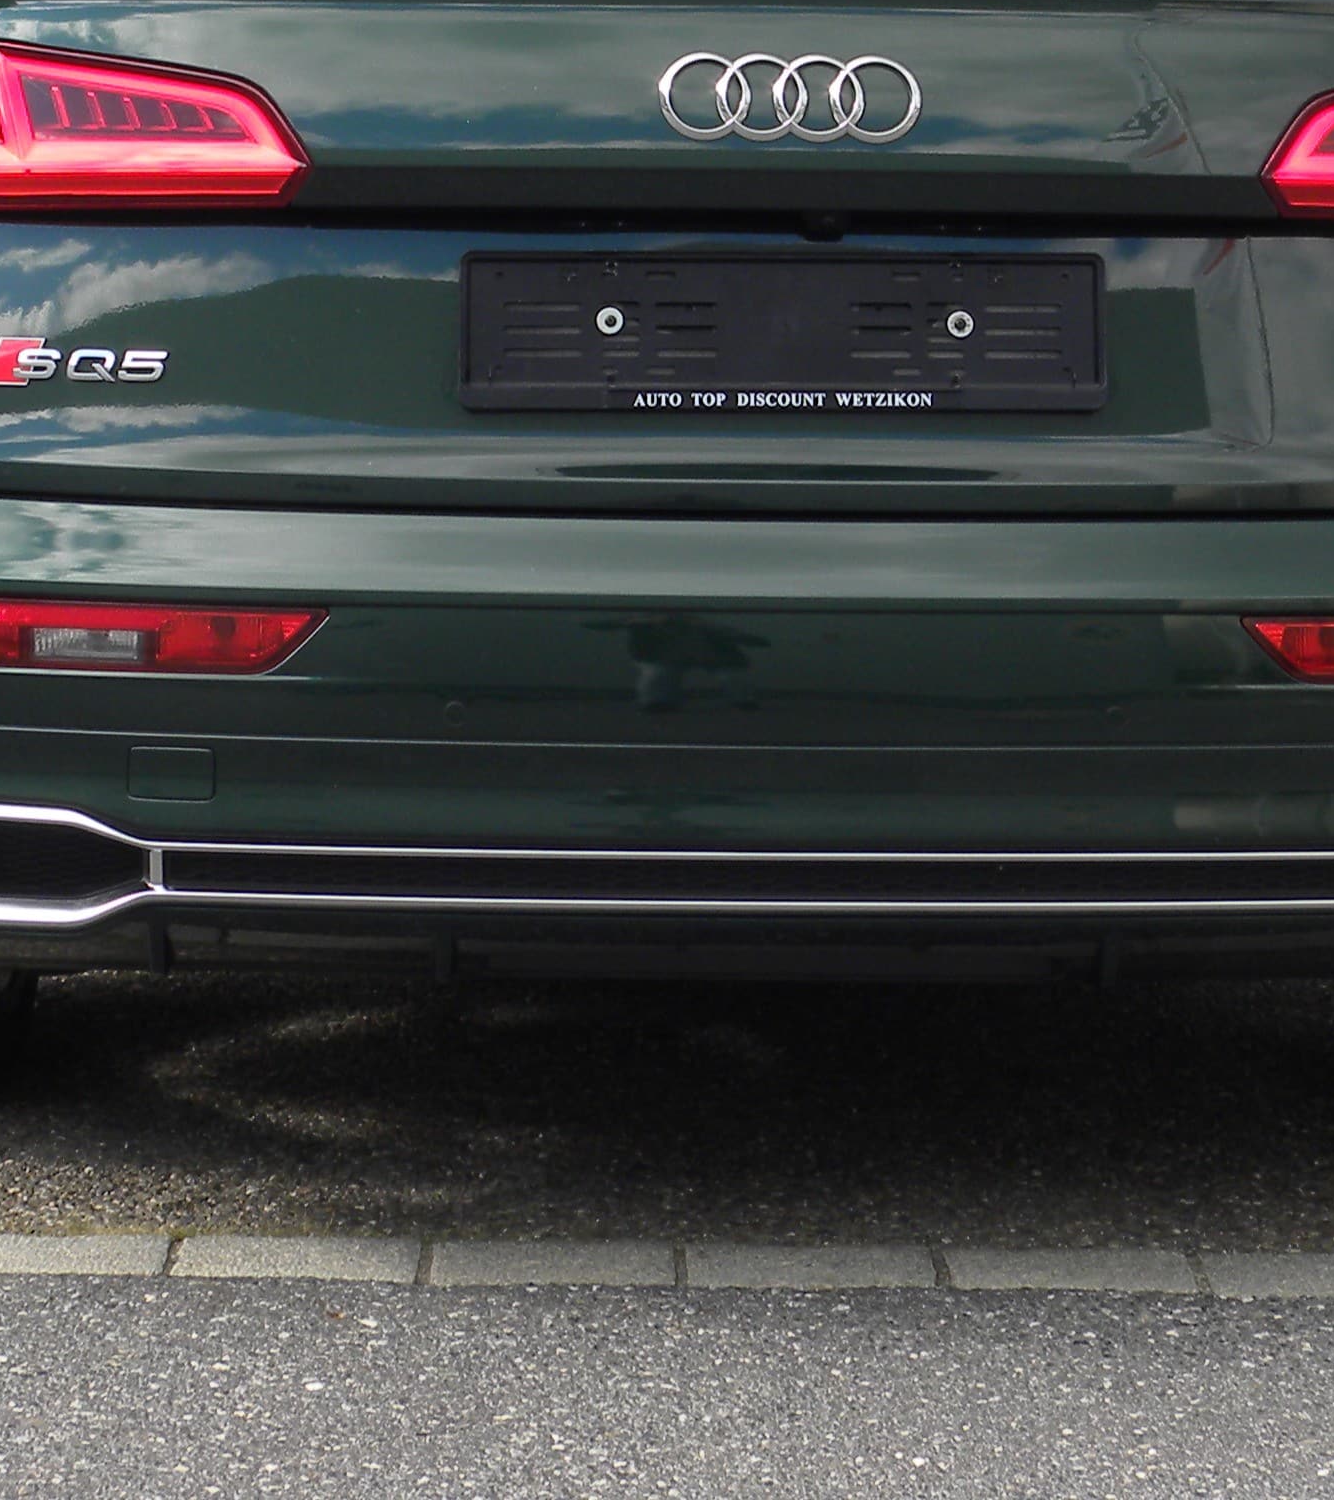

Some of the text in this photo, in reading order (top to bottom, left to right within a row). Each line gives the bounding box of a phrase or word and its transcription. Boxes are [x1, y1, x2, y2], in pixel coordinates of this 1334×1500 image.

[12, 347, 169, 383] SQ5
[633, 393, 933, 407] AUTO TOP DISCOUNT WETZIKON
